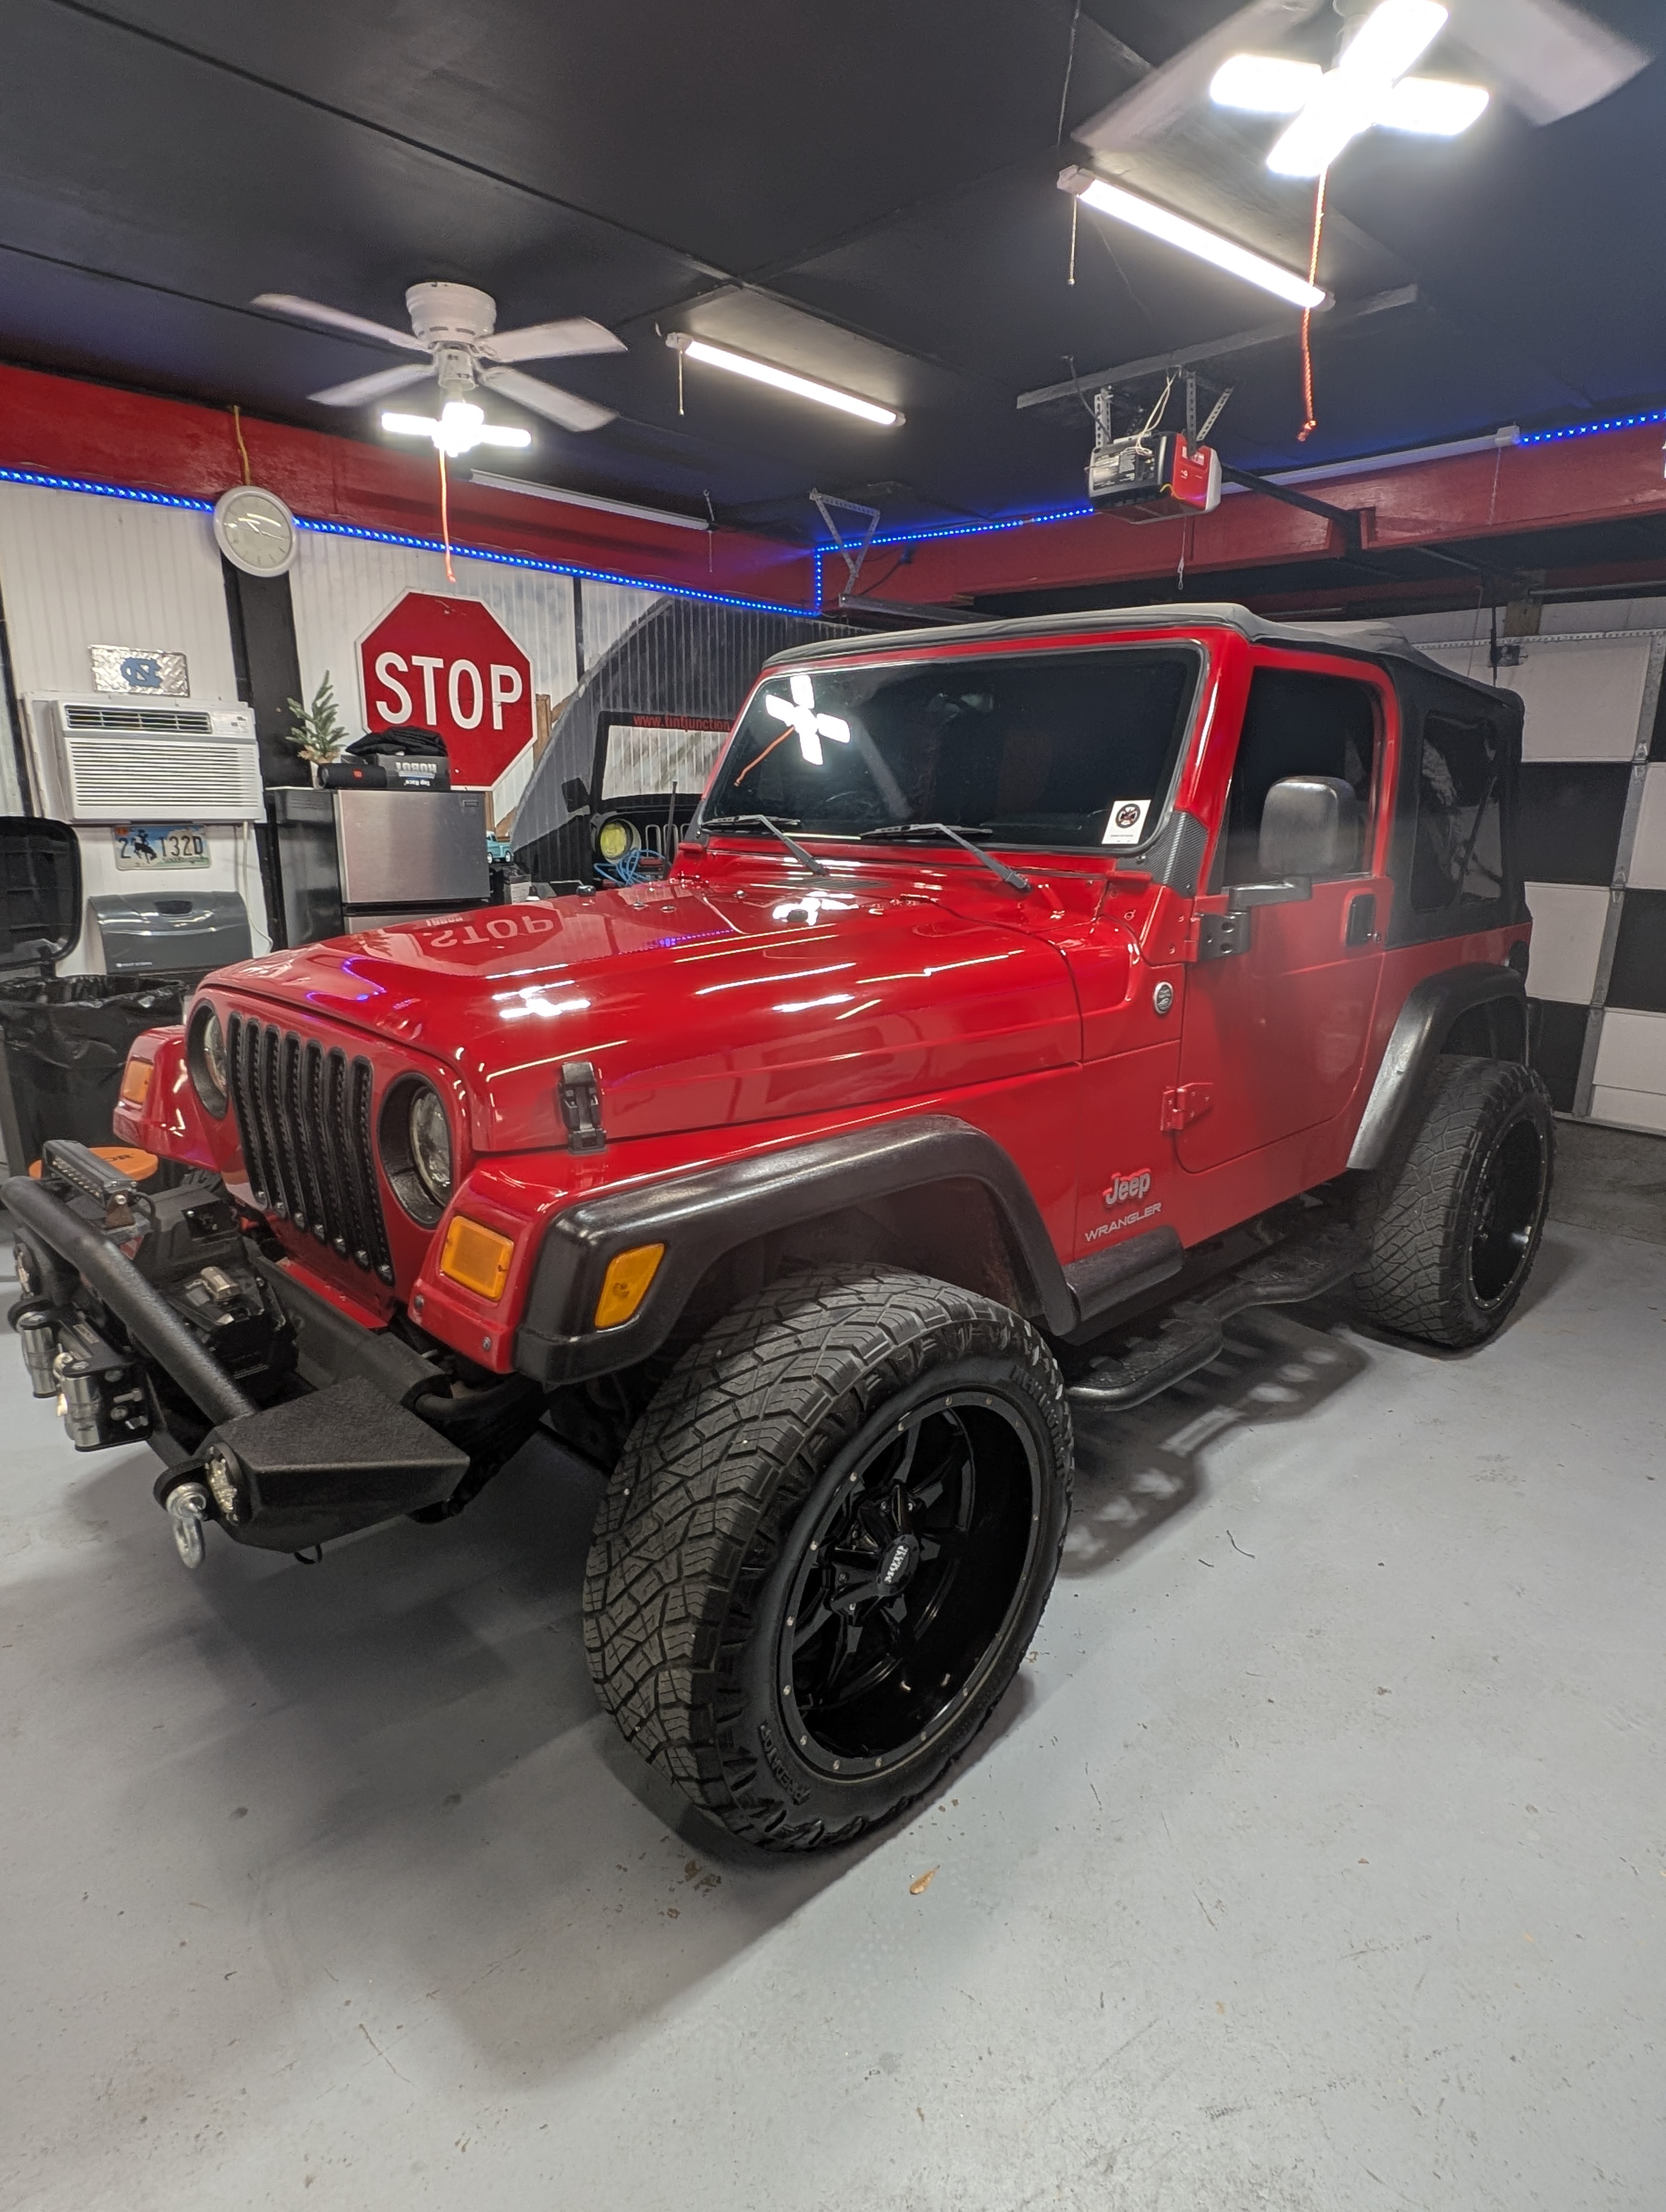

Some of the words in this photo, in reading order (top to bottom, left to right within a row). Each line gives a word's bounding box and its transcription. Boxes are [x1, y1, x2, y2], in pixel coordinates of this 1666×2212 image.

[375, 652, 523, 730] STOP
[118, 837, 131, 859] 2
[1105, 1172, 1151, 1205] Jeep
[1085, 1203, 1162, 1242] WRANGLER
[760, 1725, 811, 1804] PREDATOR
